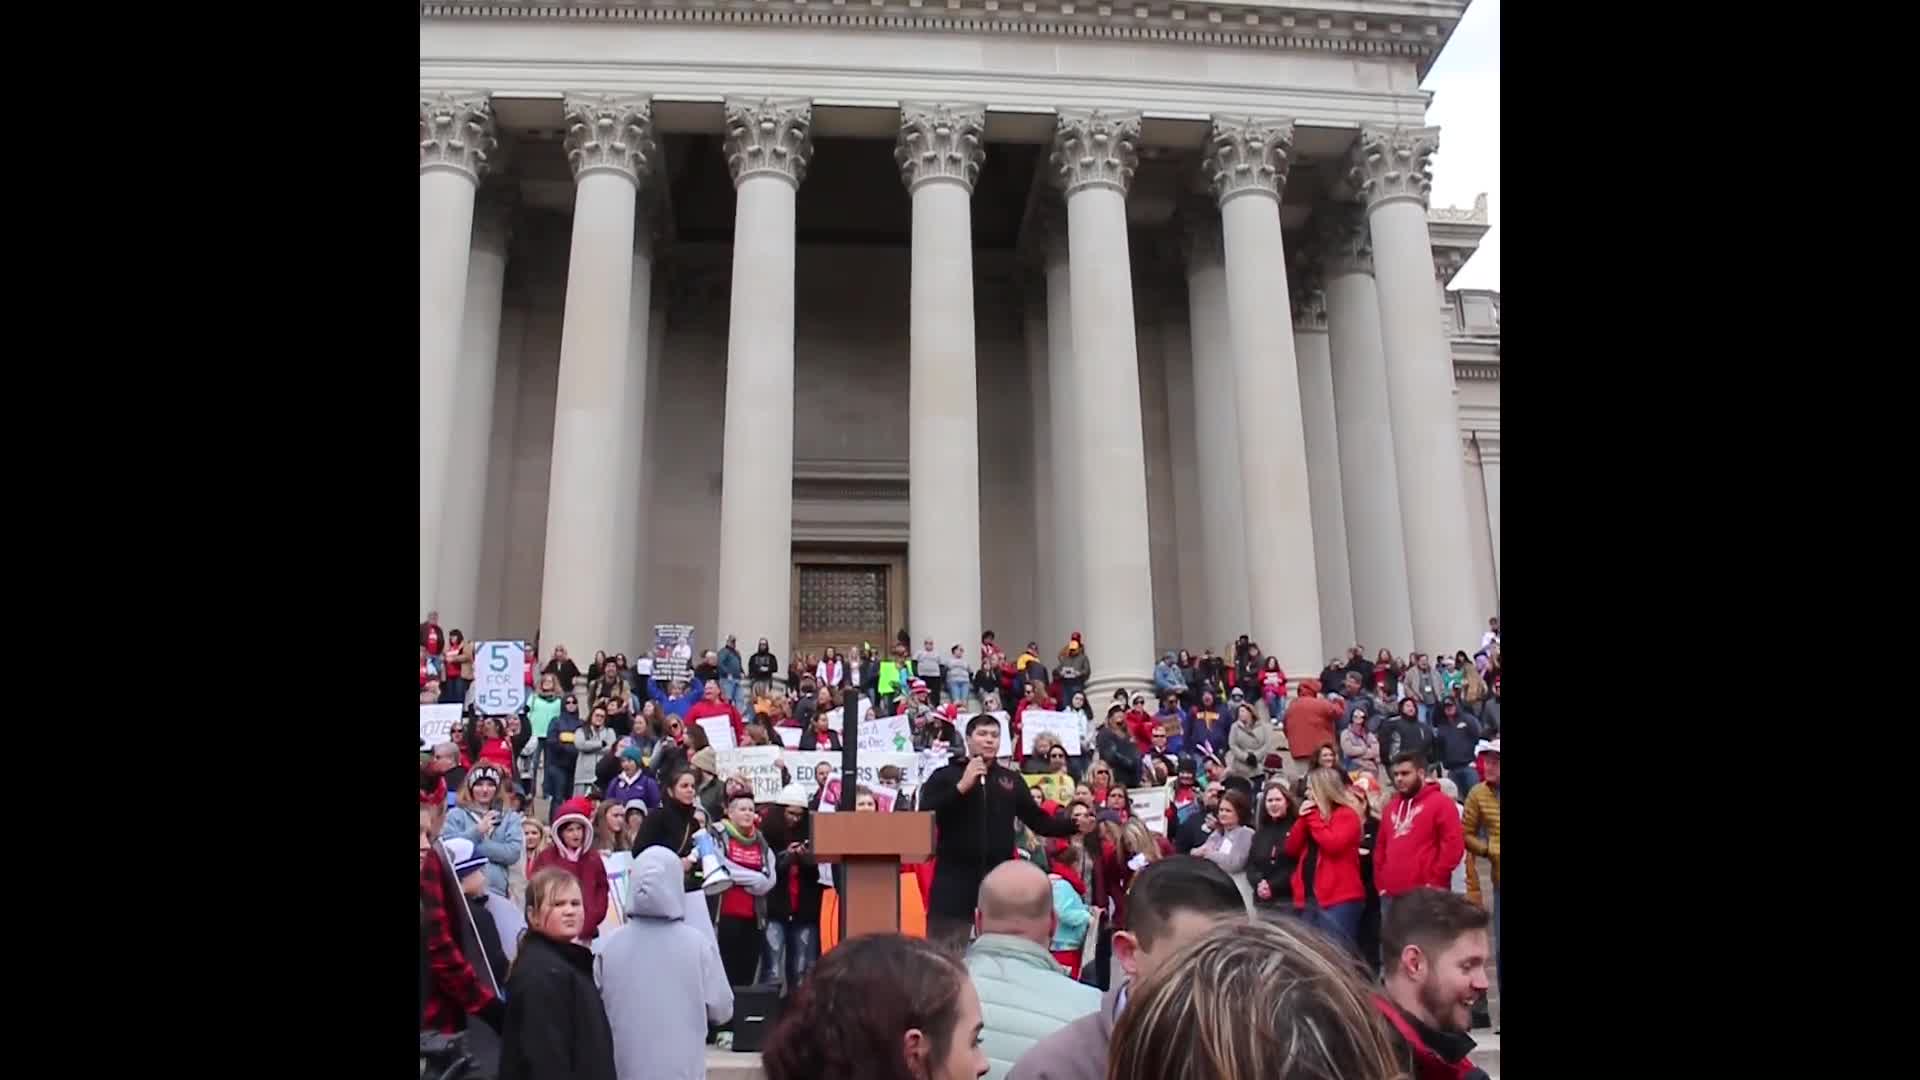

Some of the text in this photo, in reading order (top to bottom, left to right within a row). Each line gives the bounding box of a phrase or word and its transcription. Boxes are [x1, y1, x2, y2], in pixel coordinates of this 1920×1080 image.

[489, 645, 510, 672] 5
[487, 674, 511, 686] FOR
[422, 720, 453, 738] OTE
